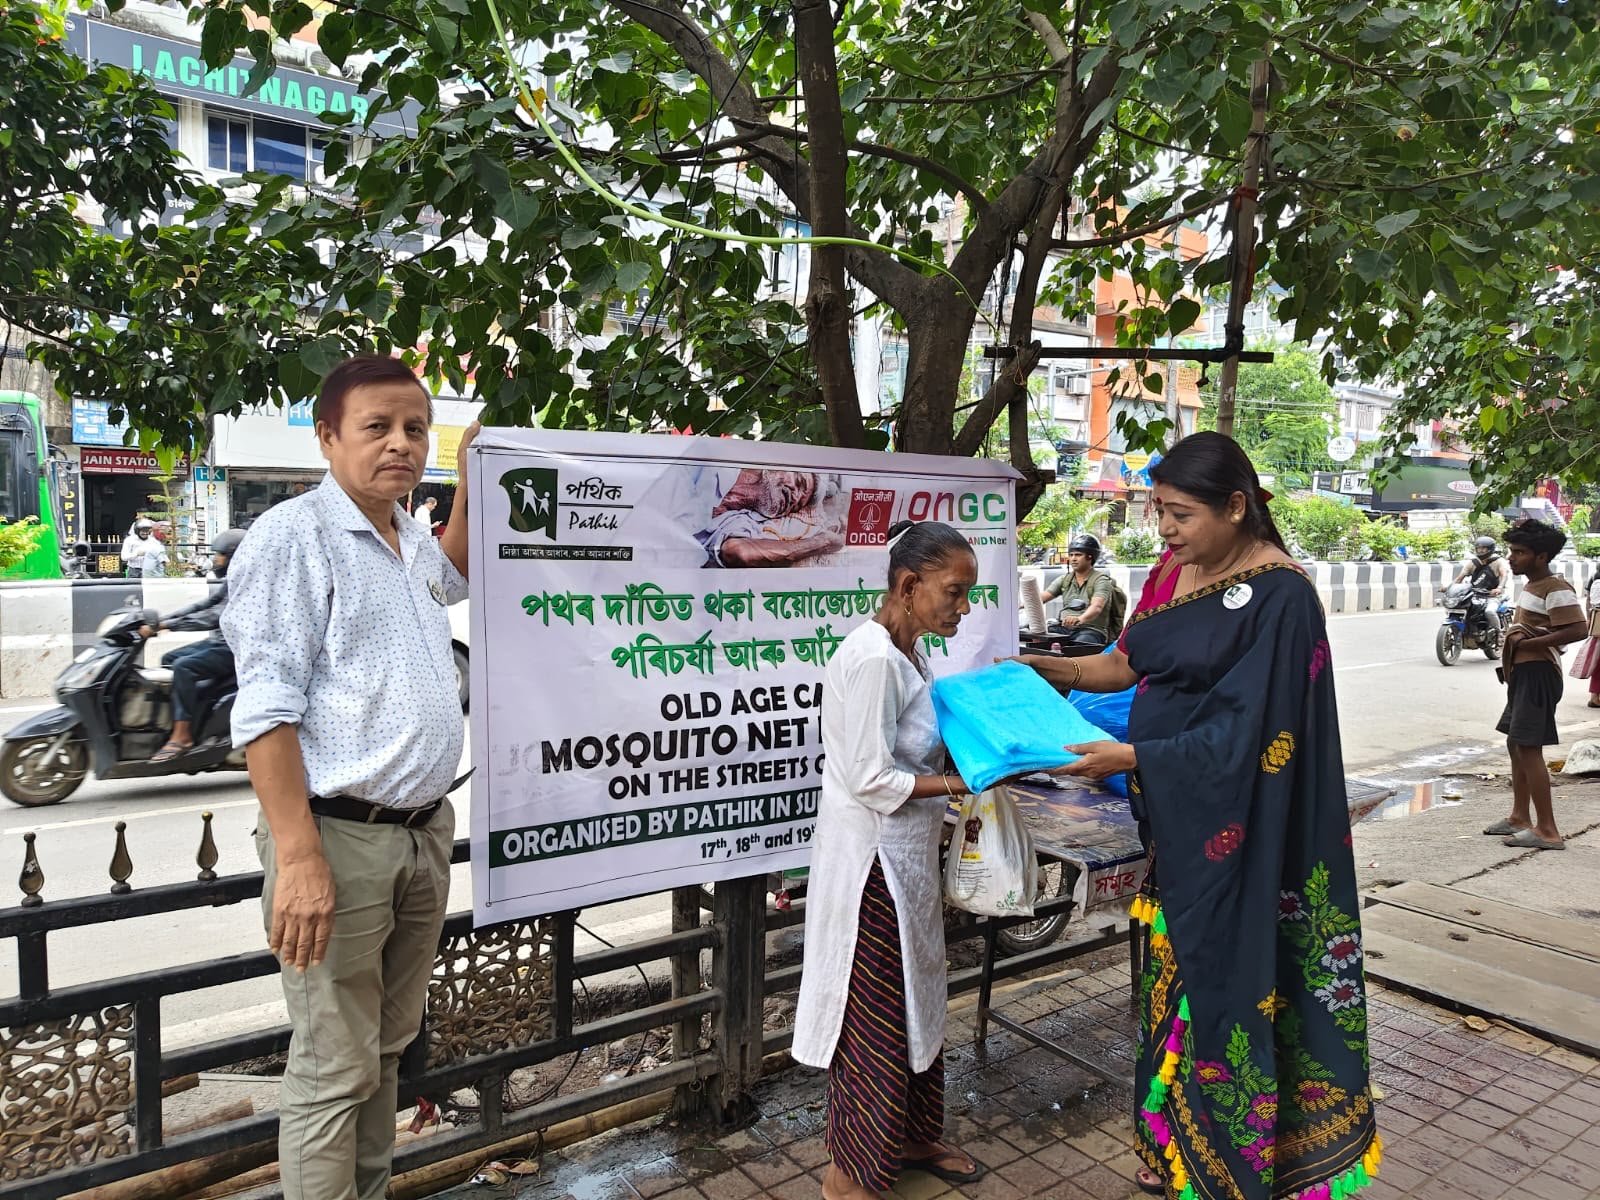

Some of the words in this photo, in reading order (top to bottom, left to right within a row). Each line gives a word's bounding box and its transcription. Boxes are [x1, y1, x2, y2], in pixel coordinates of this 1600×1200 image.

[259, 76, 369, 125] NAGAR
[82, 455, 112, 465] JAIN
[115, 456, 188, 468] STATIORS
[565, 476, 622, 501] পথিক
[569, 511, 619, 531] Pathik
[521, 589, 595, 627] পথৰ
[601, 582, 695, 625] দাঁতিত
[704, 588, 755, 622] থকা
[721, 634, 786, 672] আৰু
[661, 691, 722, 721] OLD
[731, 685, 788, 716] AGE
[541, 724, 738, 775] MOSQUITO
[747, 716, 809, 752] NET
[608, 773, 651, 800] ON
[658, 766, 709, 794] THE
[716, 755, 809, 788] STREETS
[502, 813, 642, 860] ORGANISED
[647, 809, 678, 836] BY
[683, 799, 765, 831] PATHIK
[769, 794, 791, 820] IN
[735, 832, 760, 854] 18th
[765, 828, 793, 849] and
